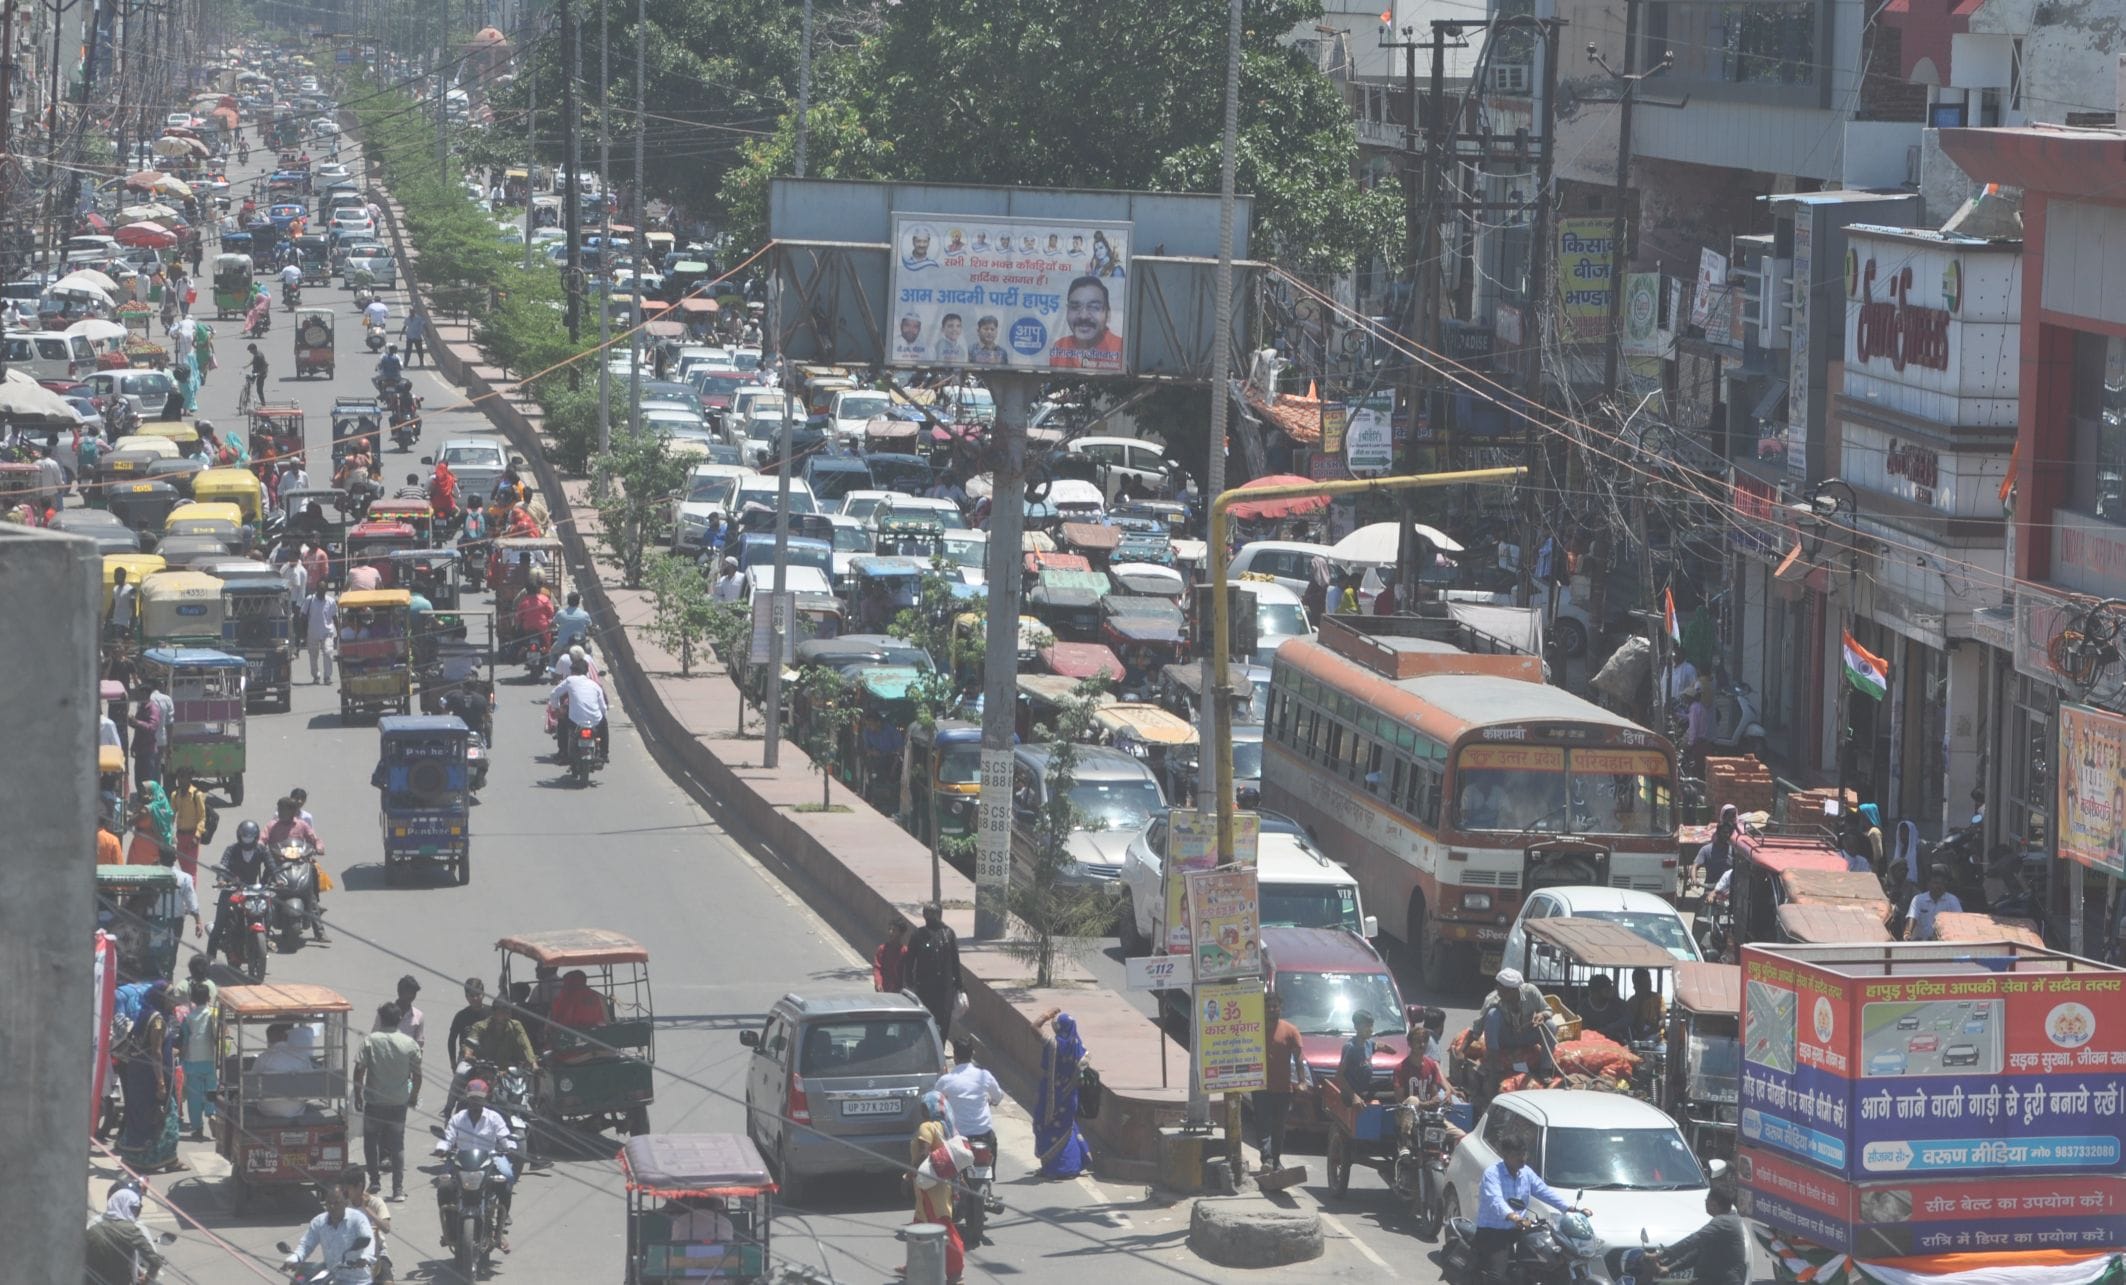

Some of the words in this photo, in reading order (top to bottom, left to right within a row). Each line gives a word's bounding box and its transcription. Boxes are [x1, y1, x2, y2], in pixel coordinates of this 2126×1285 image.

[900, 288, 933, 303] आम
[936, 284, 985, 305] आदमी
[989, 286, 1020, 307] पार्टी
[1022, 294, 1060, 315] हापुड़
[992, 762, 1006, 774] CS
[992, 776, 1006, 787] 88
[991, 806, 1005, 818] CS
[991, 820, 1004, 832] 88
[989, 850, 1003, 863] CS
[989, 865, 1003, 876] 88
[1337, 890, 1352, 899] VIP
[1156, 963, 1174, 974] 112
[1866, 984, 1901, 1001] हापुड़
[1906, 982, 1946, 1000] पुलिस
[1949, 980, 1997, 995] आपकी
[2001, 981, 2027, 994] सेवा
[2031, 977, 2047, 993] में
[2048, 977, 2081, 993] सदैव
[2085, 979, 2121, 993] तत्पर
[1205, 1025, 1226, 1035] कार
[2009, 1051, 2037, 1069] सड़क
[2077, 1048, 2108, 1066] जीवन
[848, 1103, 859, 1112] UP
[861, 1103, 871, 1112] 37
[872, 1103, 878, 1111] K
[879, 1101, 900, 1111] 2075
[1861, 1088, 1893, 1120] आगे
[1896, 1088, 1928, 1118] जाने
[1931, 1085, 1964, 1118] वाली
[1968, 1084, 2002, 1124] गाड़ी
[2005, 1085, 2020, 1117] से
[2024, 1082, 2046, 1125] दूरी
[2050, 1084, 2090, 1115] बनाये
[1971, 1140, 2027, 1164] मीडिया
[2055, 1144, 2115, 1158] 9837332080
[1924, 1195, 1955, 1213] सीट
[1960, 1194, 1993, 1211] बेल्ट
[1997, 1197, 2018, 1210] का
[2023, 1192, 2075, 1209] उपयोग
[1921, 1232, 1952, 1247] रात्रि
[1956, 1231, 1971, 1246] में
[1975, 1230, 2009, 1246] डिपर
[2014, 1232, 2032, 1244] का
[2037, 1228, 2077, 1243] प्रयोग
